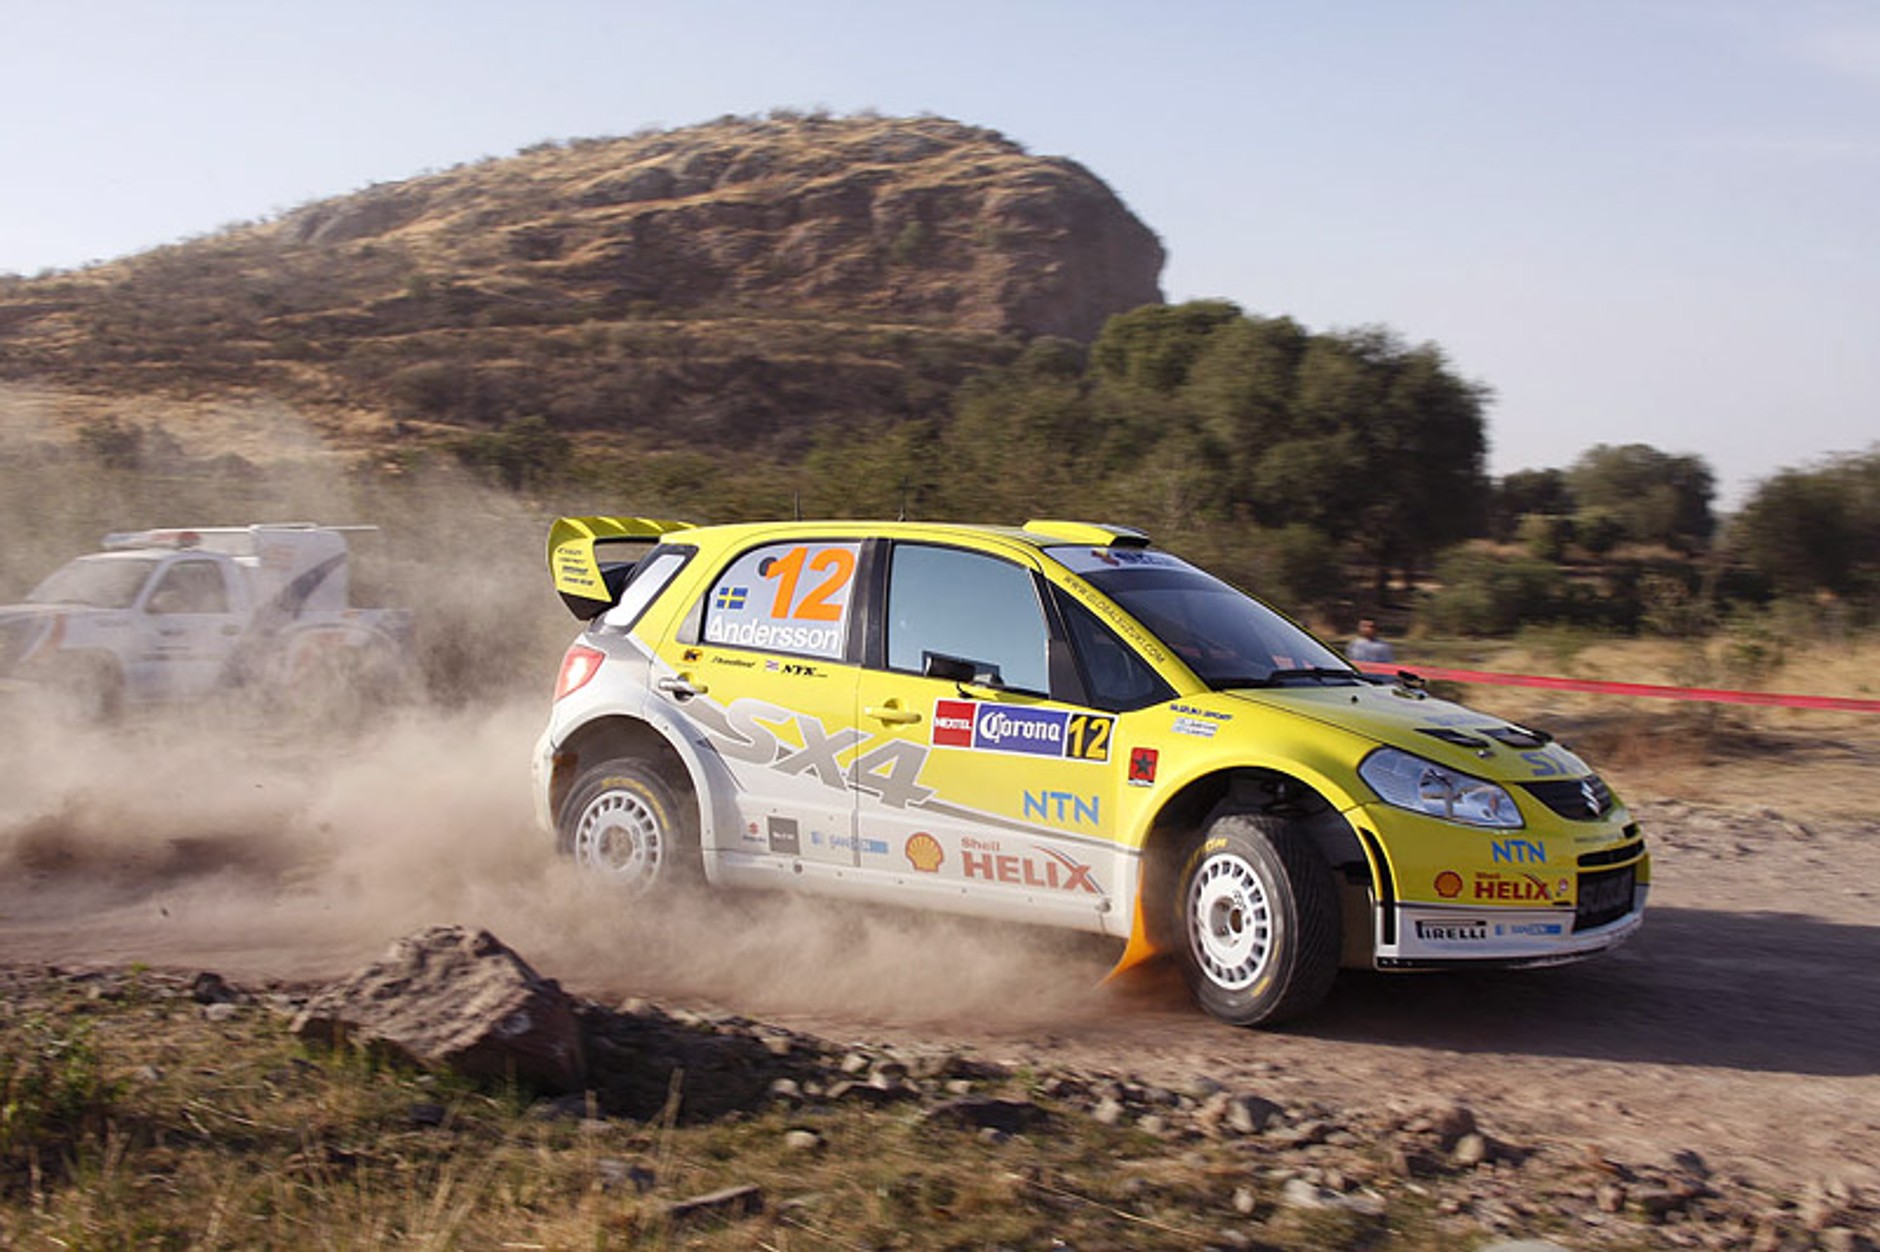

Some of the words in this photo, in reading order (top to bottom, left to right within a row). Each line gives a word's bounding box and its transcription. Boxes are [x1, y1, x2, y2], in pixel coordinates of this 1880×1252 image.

[765, 546, 856, 622] 12
[709, 615, 839, 649] Andersson
[708, 698, 938, 809] SX4
[979, 712, 1061, 743] Corona
[1069, 715, 1112, 760] 12
[1024, 790, 1099, 826] NTN
[961, 837, 1001, 850] Shell
[1491, 839, 1547, 864] NTN
[961, 850, 1099, 894] HELIX
[1474, 880, 1550, 900] HELIX
[1415, 920, 1487, 939] PIRELLI
